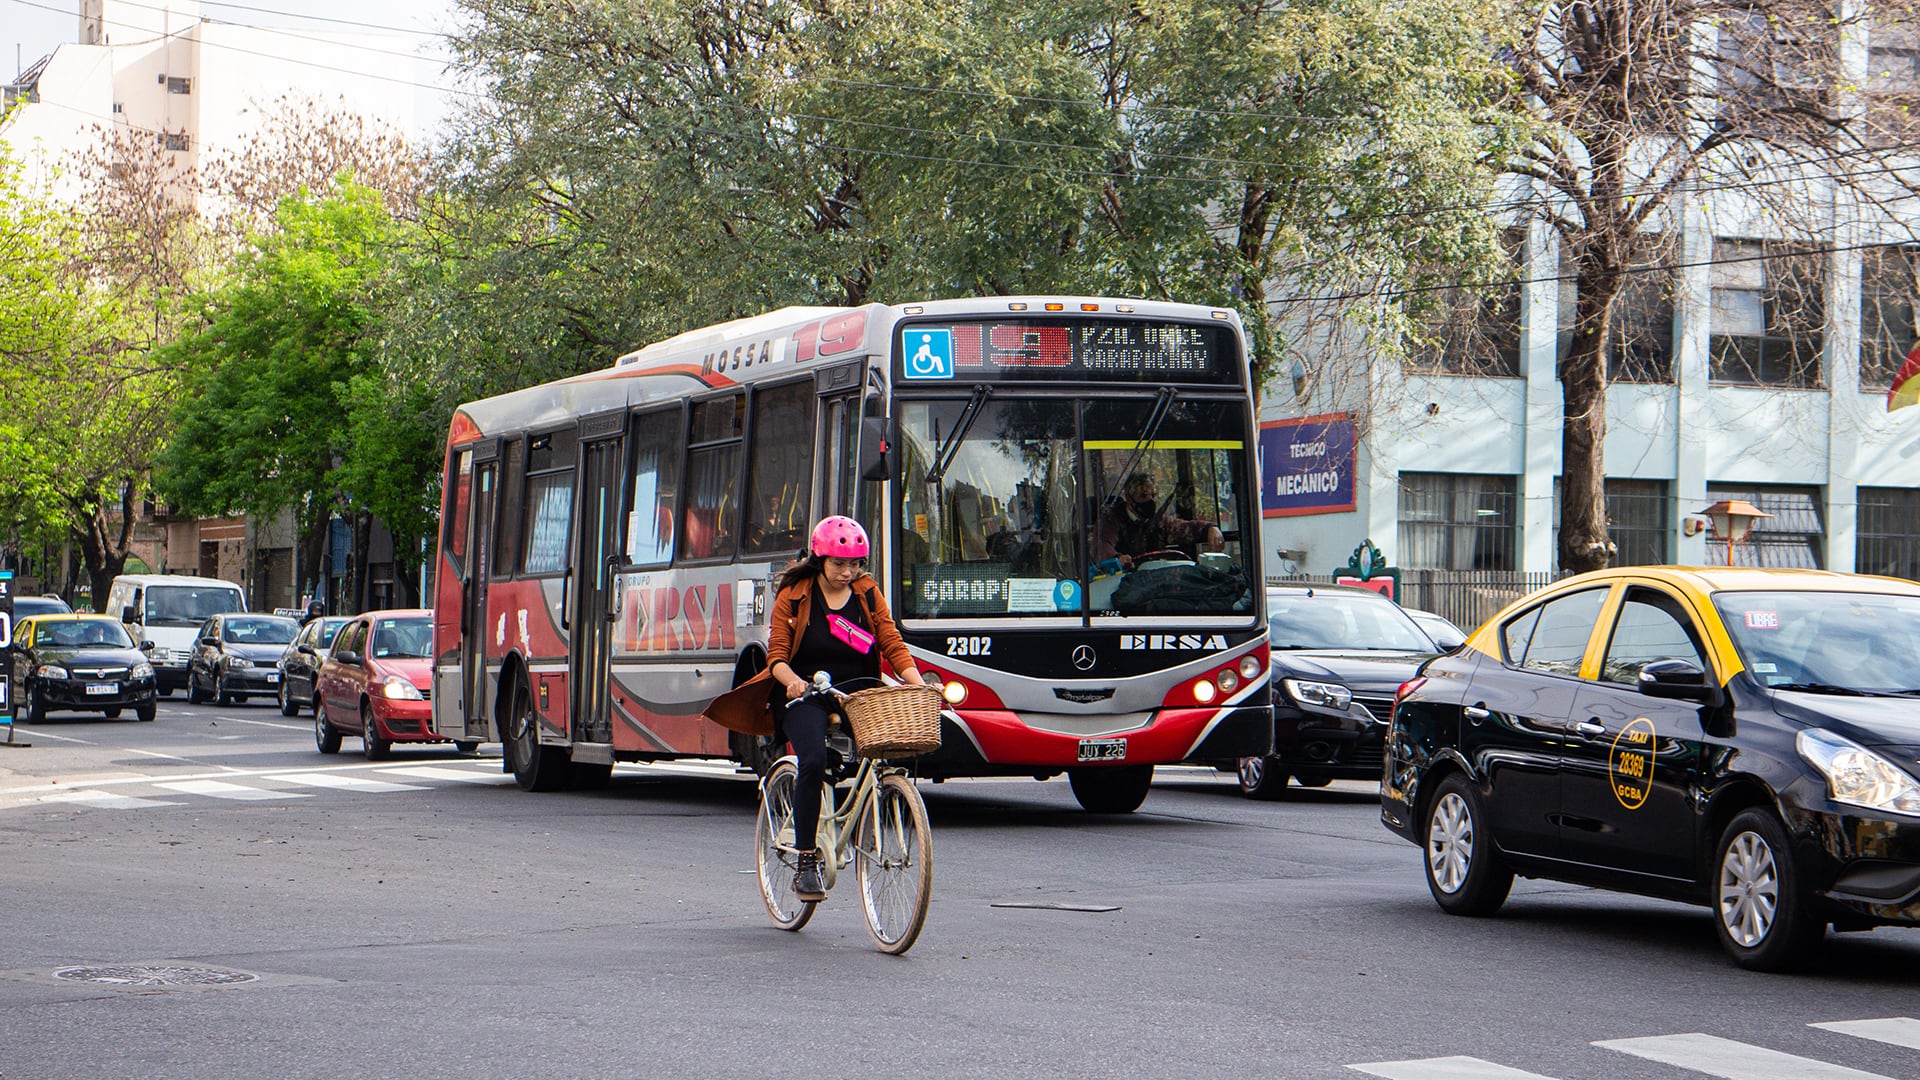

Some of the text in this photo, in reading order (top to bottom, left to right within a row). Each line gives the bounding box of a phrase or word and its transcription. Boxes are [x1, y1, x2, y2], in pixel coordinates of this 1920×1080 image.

[701, 310, 866, 376] MOSSA 19
[952, 325, 1073, 367] 19
[628, 576, 650, 586] GRUPO
[755, 594, 765, 614] 19
[625, 583, 736, 651] ERSA
[1749, 613, 1777, 627] LIBRE
[947, 637, 991, 656] 2302
[1120, 634, 1228, 650] ERSA
[1629, 730, 1648, 744] TAXI
[1080, 744, 1125, 757] JUY 226
[1618, 751, 1644, 777] 28369
[1618, 784, 1642, 800] GCBA
